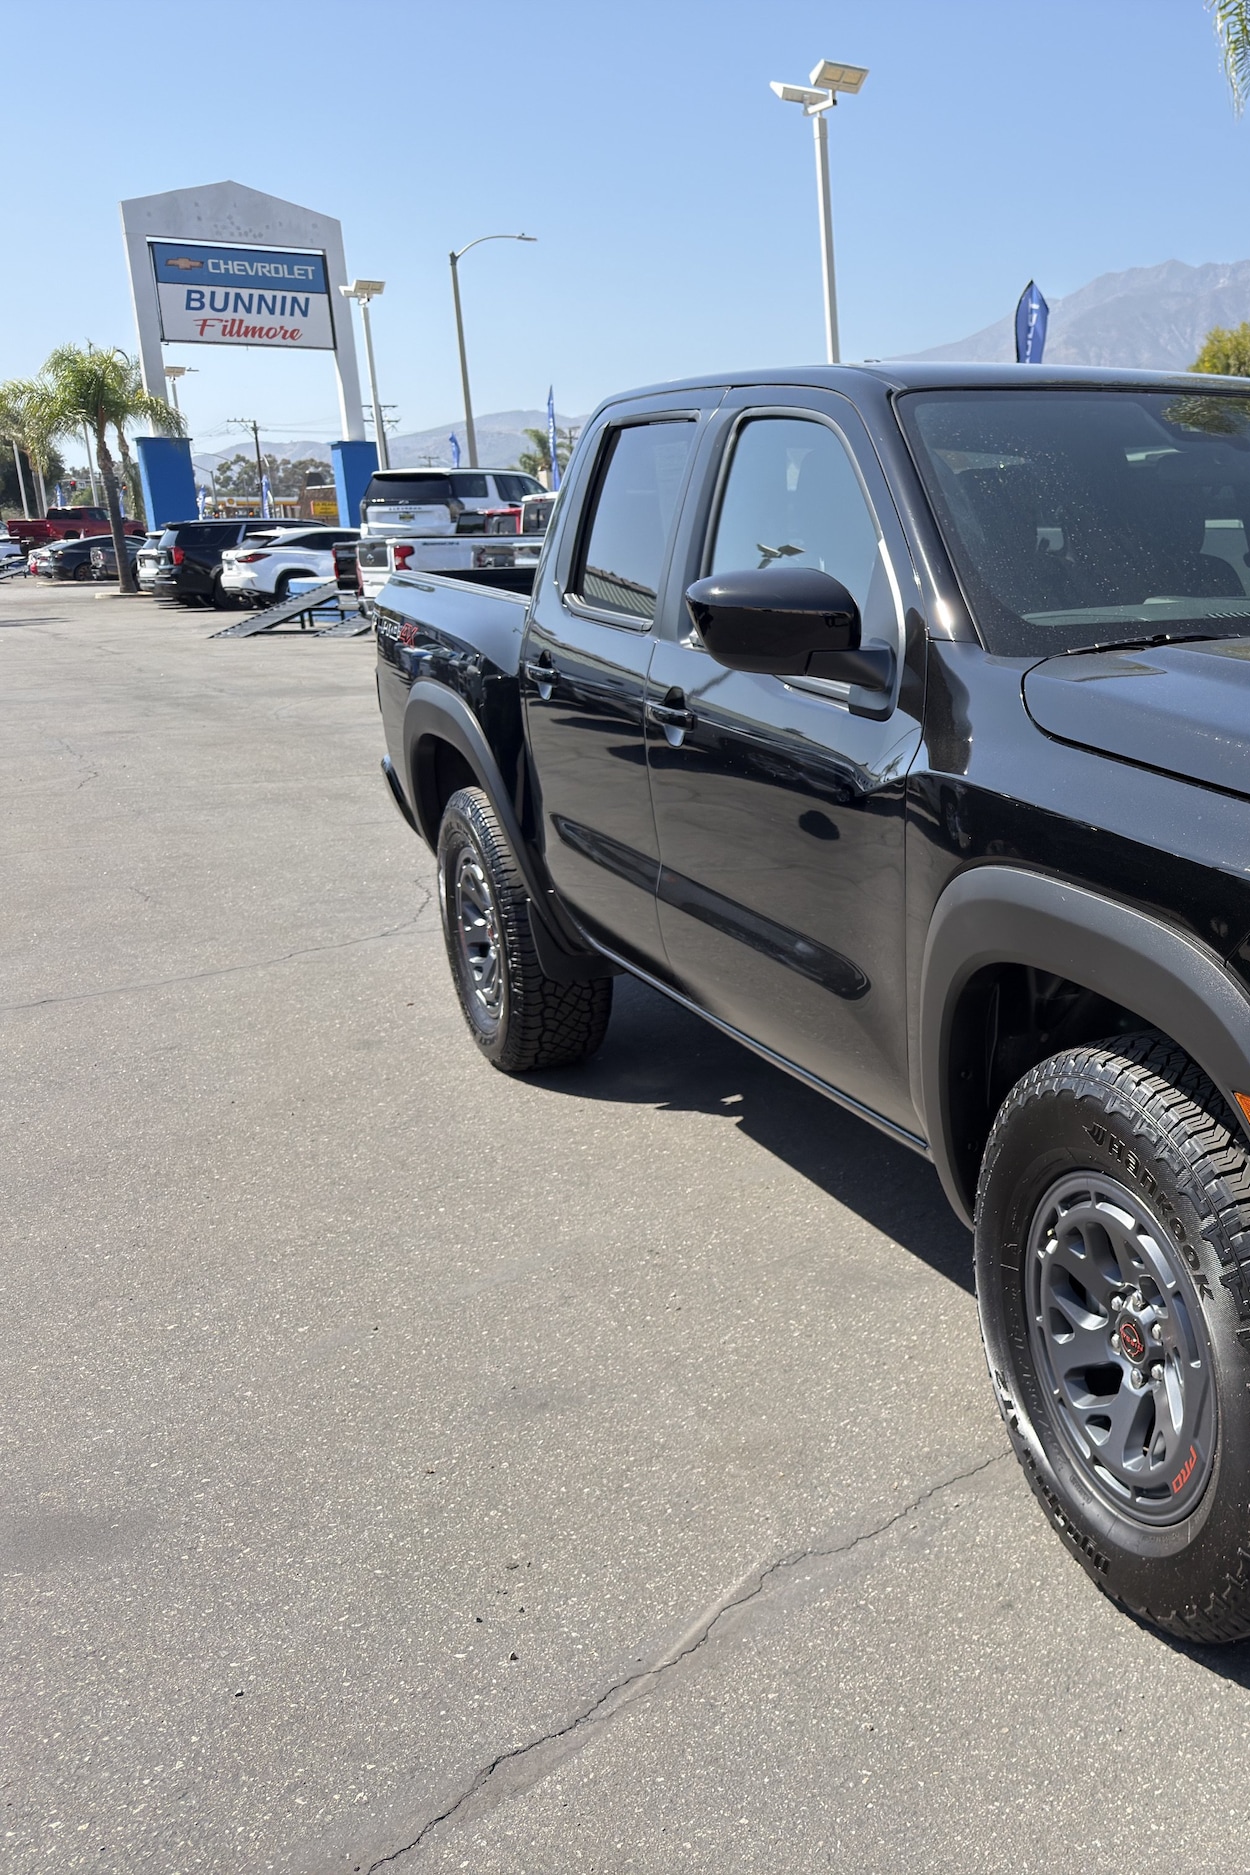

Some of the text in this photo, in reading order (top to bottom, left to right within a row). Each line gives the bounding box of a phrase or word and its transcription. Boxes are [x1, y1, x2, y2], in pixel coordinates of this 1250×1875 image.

[207, 258, 315, 280] CHEVROLET
[185, 288, 310, 318] BUNNIN
[193, 317, 302, 341] Fillmore
[1171, 1444, 1199, 1494] PRO
